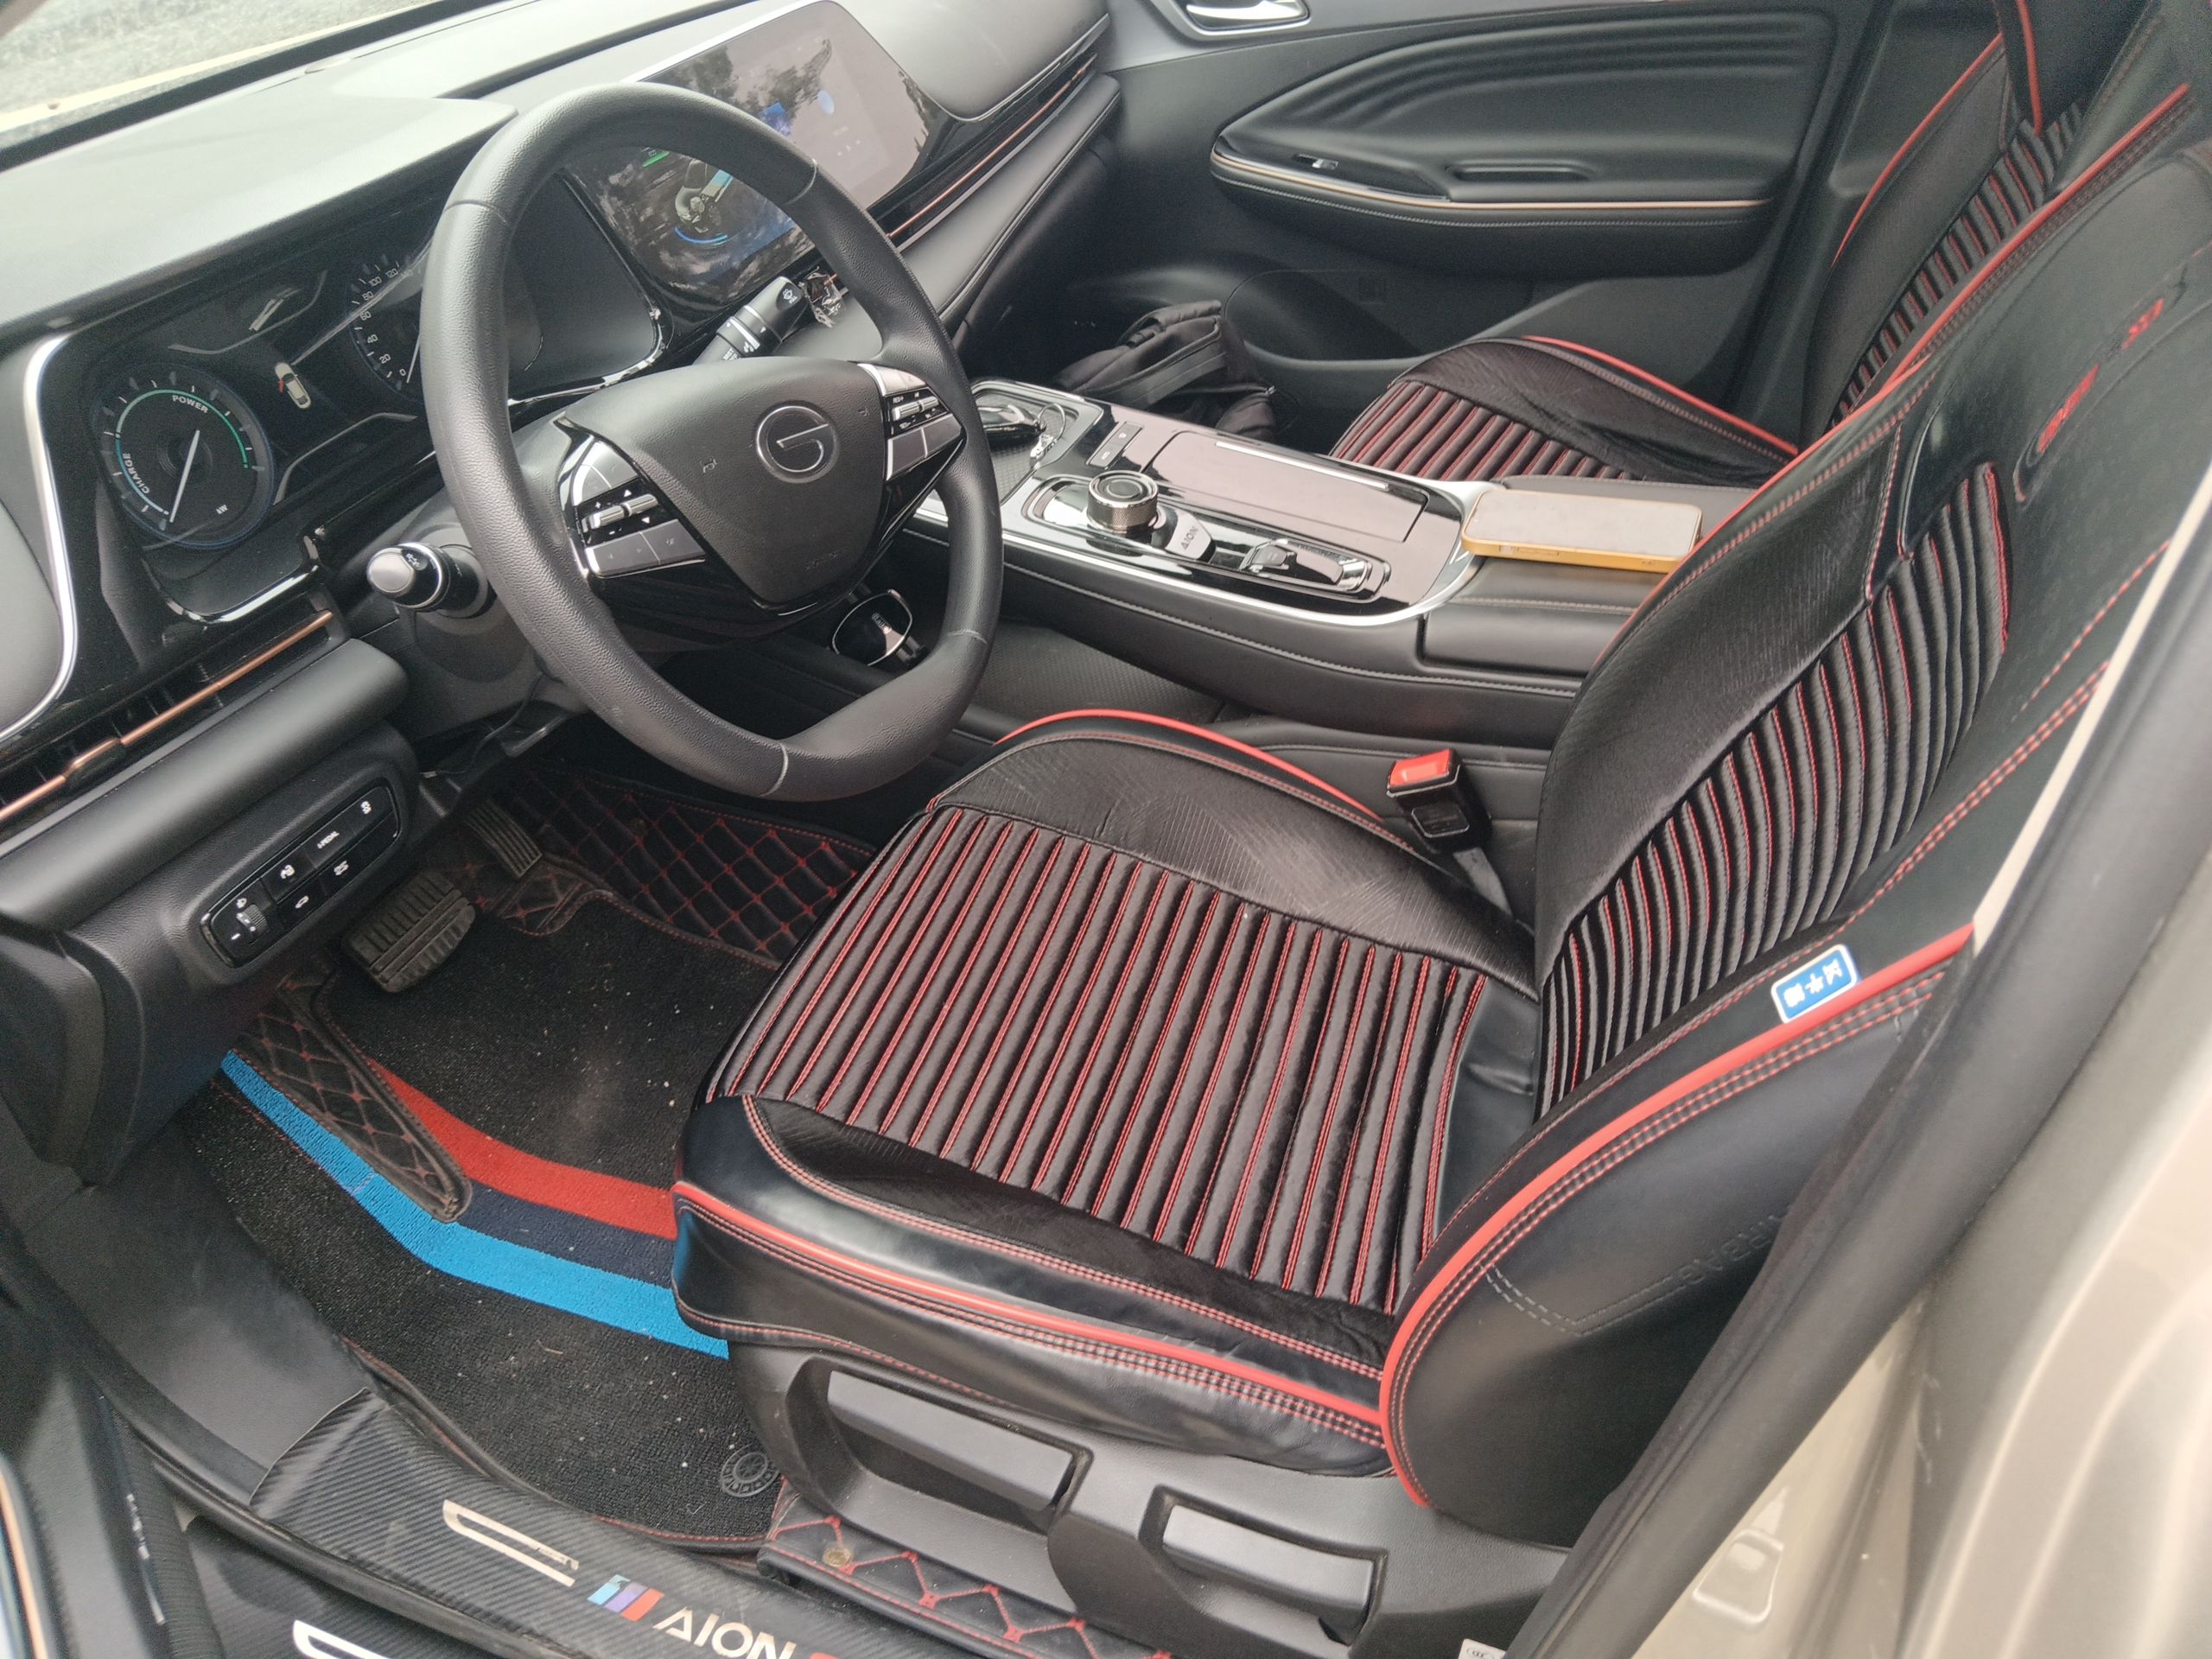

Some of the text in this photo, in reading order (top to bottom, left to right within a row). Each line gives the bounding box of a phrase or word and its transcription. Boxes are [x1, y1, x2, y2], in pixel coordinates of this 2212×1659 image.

[385, 268, 398, 278] 120
[368, 276, 382, 288] 100
[362, 290, 374, 301] 80
[359, 310, 372, 321] 60
[367, 334, 378, 344] 40
[379, 353, 391, 364] 20
[399, 368, 407, 377] 0
[172, 394, 209, 414] POWER
[122, 452, 150, 495] CHARGE
[1180, 525, 1198, 550] AION
[652, 1605, 797, 1659] AION
